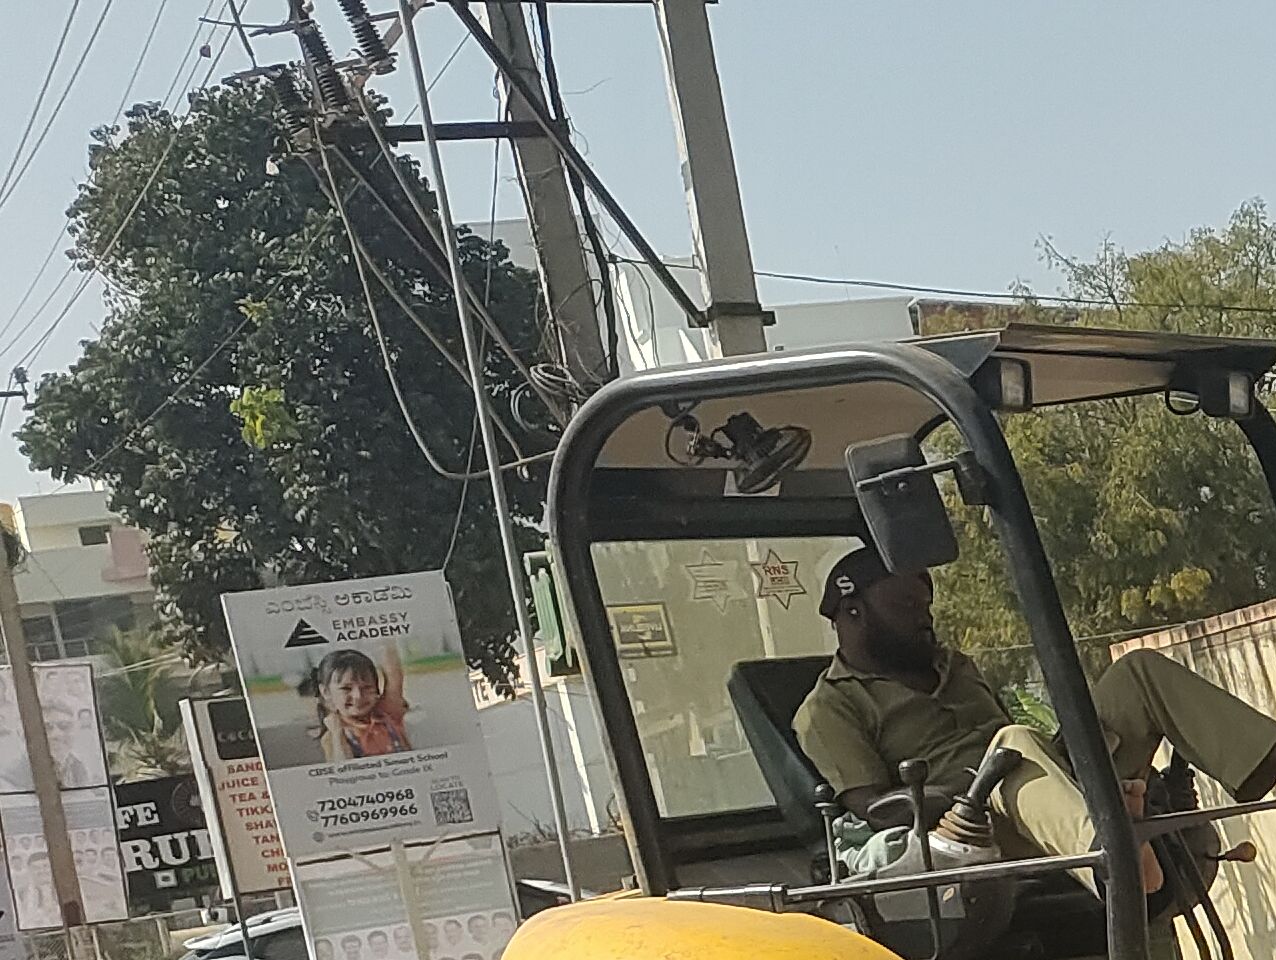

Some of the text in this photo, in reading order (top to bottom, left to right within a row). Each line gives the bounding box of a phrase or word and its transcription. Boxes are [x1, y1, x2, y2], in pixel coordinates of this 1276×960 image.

[332, 611, 408, 631] EMBASSY
[336, 623, 411, 642] ACADEMY
[416, 751, 448, 762] School
[218, 776, 259, 791] JUICE
[229, 791, 257, 804] TEA
[317, 788, 415, 813] 7204740968
[320, 803, 418, 828] 7760969966
[244, 819, 277, 832] SHA
